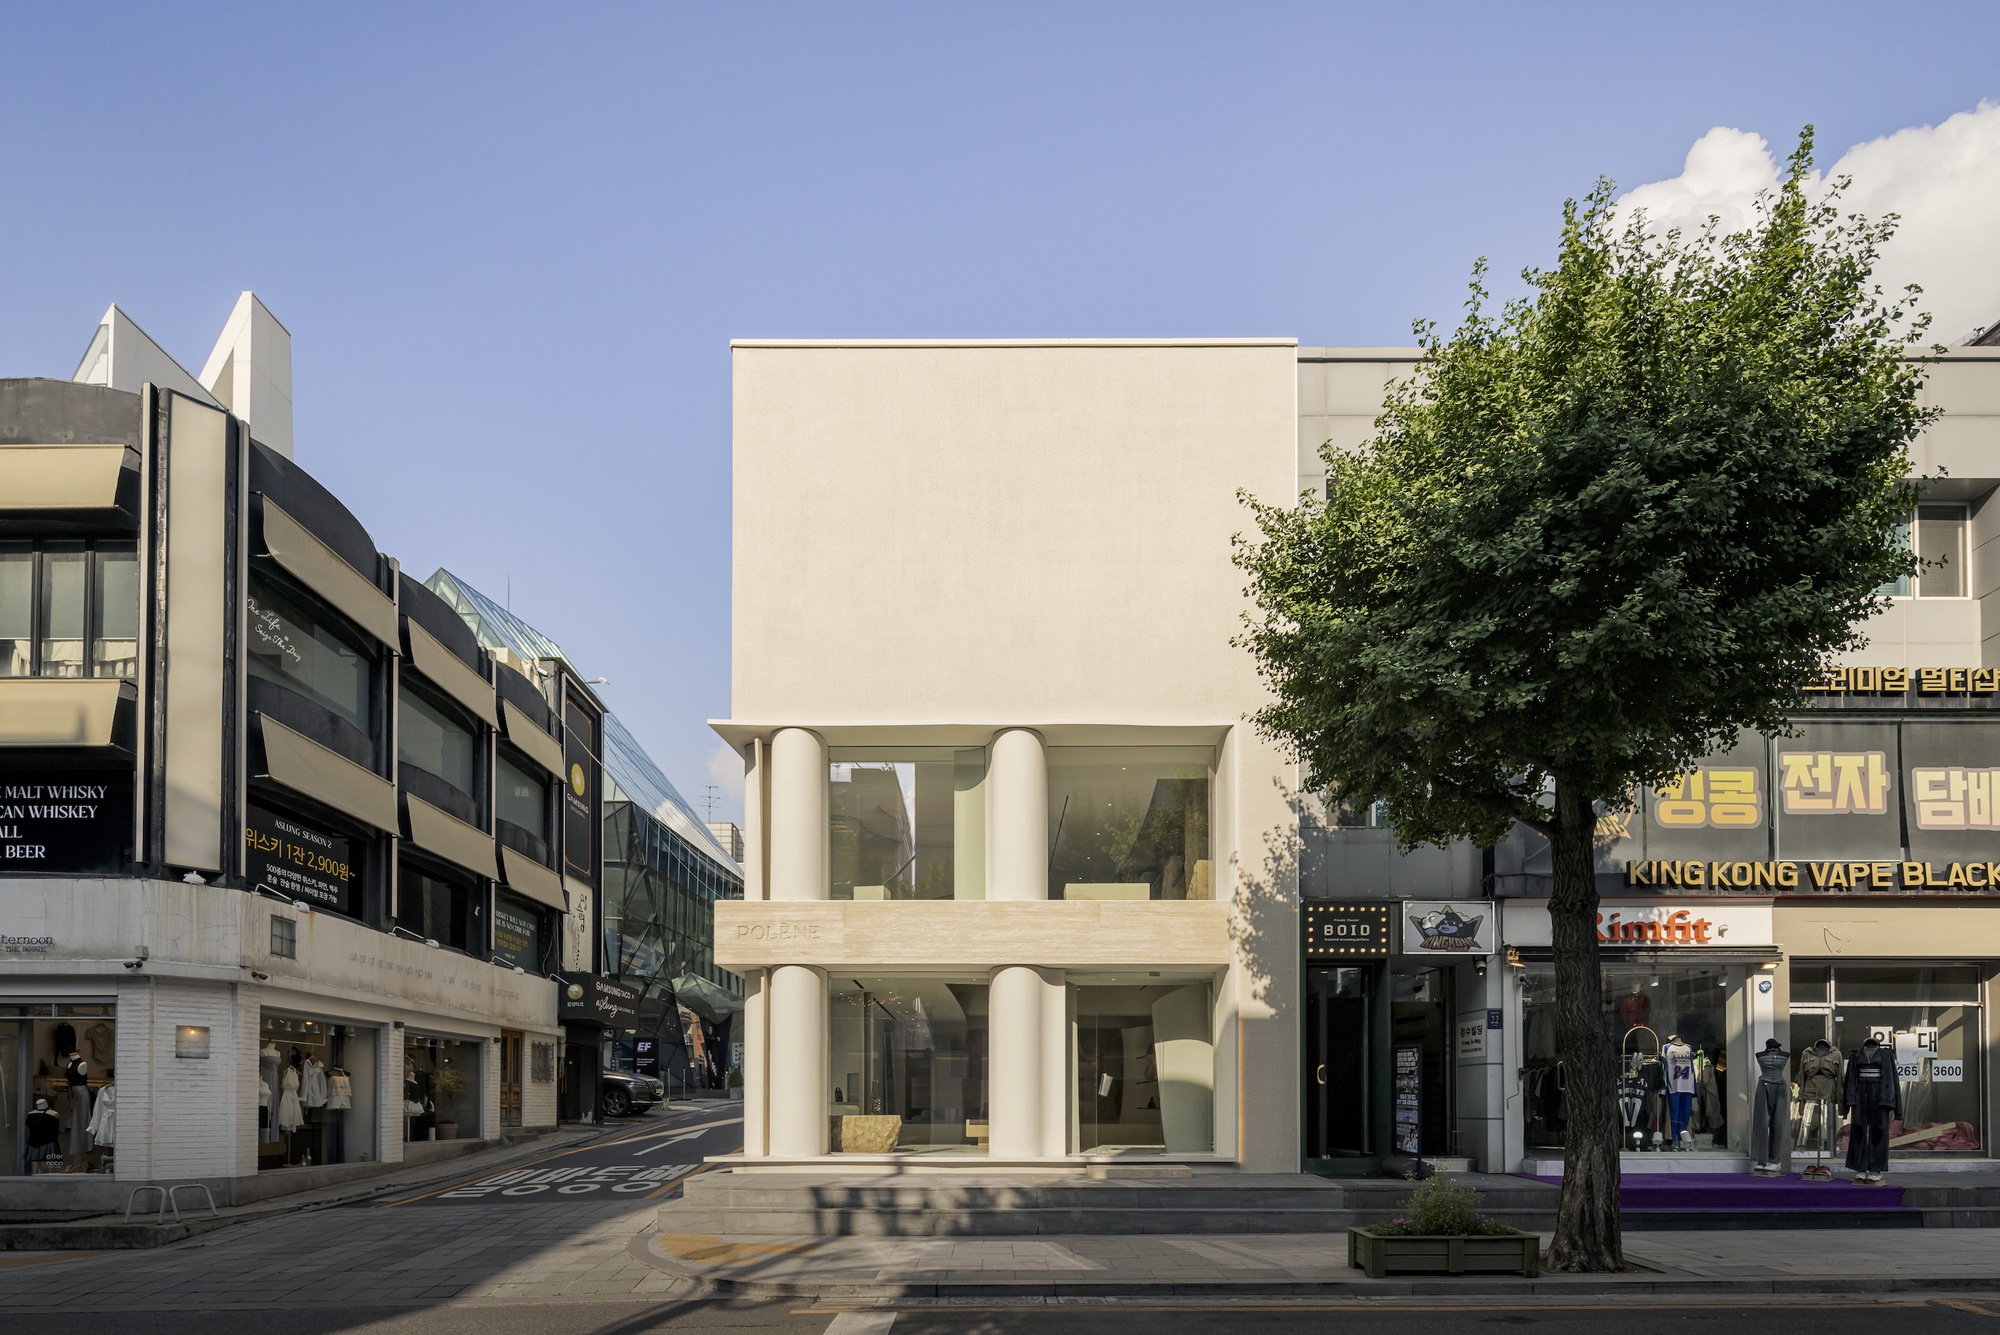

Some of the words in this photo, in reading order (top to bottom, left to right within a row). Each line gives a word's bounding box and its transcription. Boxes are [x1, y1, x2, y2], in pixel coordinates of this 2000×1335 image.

[273, 634, 285, 650] The
[286, 644, 301, 662] Day
[1802, 666, 1909, 691] 리미엄
[1920, 666, 2000, 691] 멀티샵
[5, 786, 44, 799] MALT
[47, 786, 107, 799] WHISKY
[1656, 768, 1759, 825] 킹콩
[1783, 753, 1887, 811] 전자
[1916, 769, 2000, 826] 담배
[28, 805, 98, 819] WHISKEY
[0, 825, 22, 838] LL
[302, 830, 326, 847] SEASON
[326, 840, 332, 849] 2
[5, 845, 46, 859] BEER
[246, 827, 282, 859] 위스키
[286, 843, 306, 866] 1잔
[1810, 861, 1894, 887] VAPE
[1902, 861, 2000, 887] BLACK
[737, 922, 821, 940] POLÈNE
[1323, 924, 1370, 936] BOID
[636, 1041, 652, 1052] EF
[1674, 1065, 1691, 1080] 24
[1933, 1066, 1962, 1077] 3600
[437, 1163, 700, 1199] 일방통행
